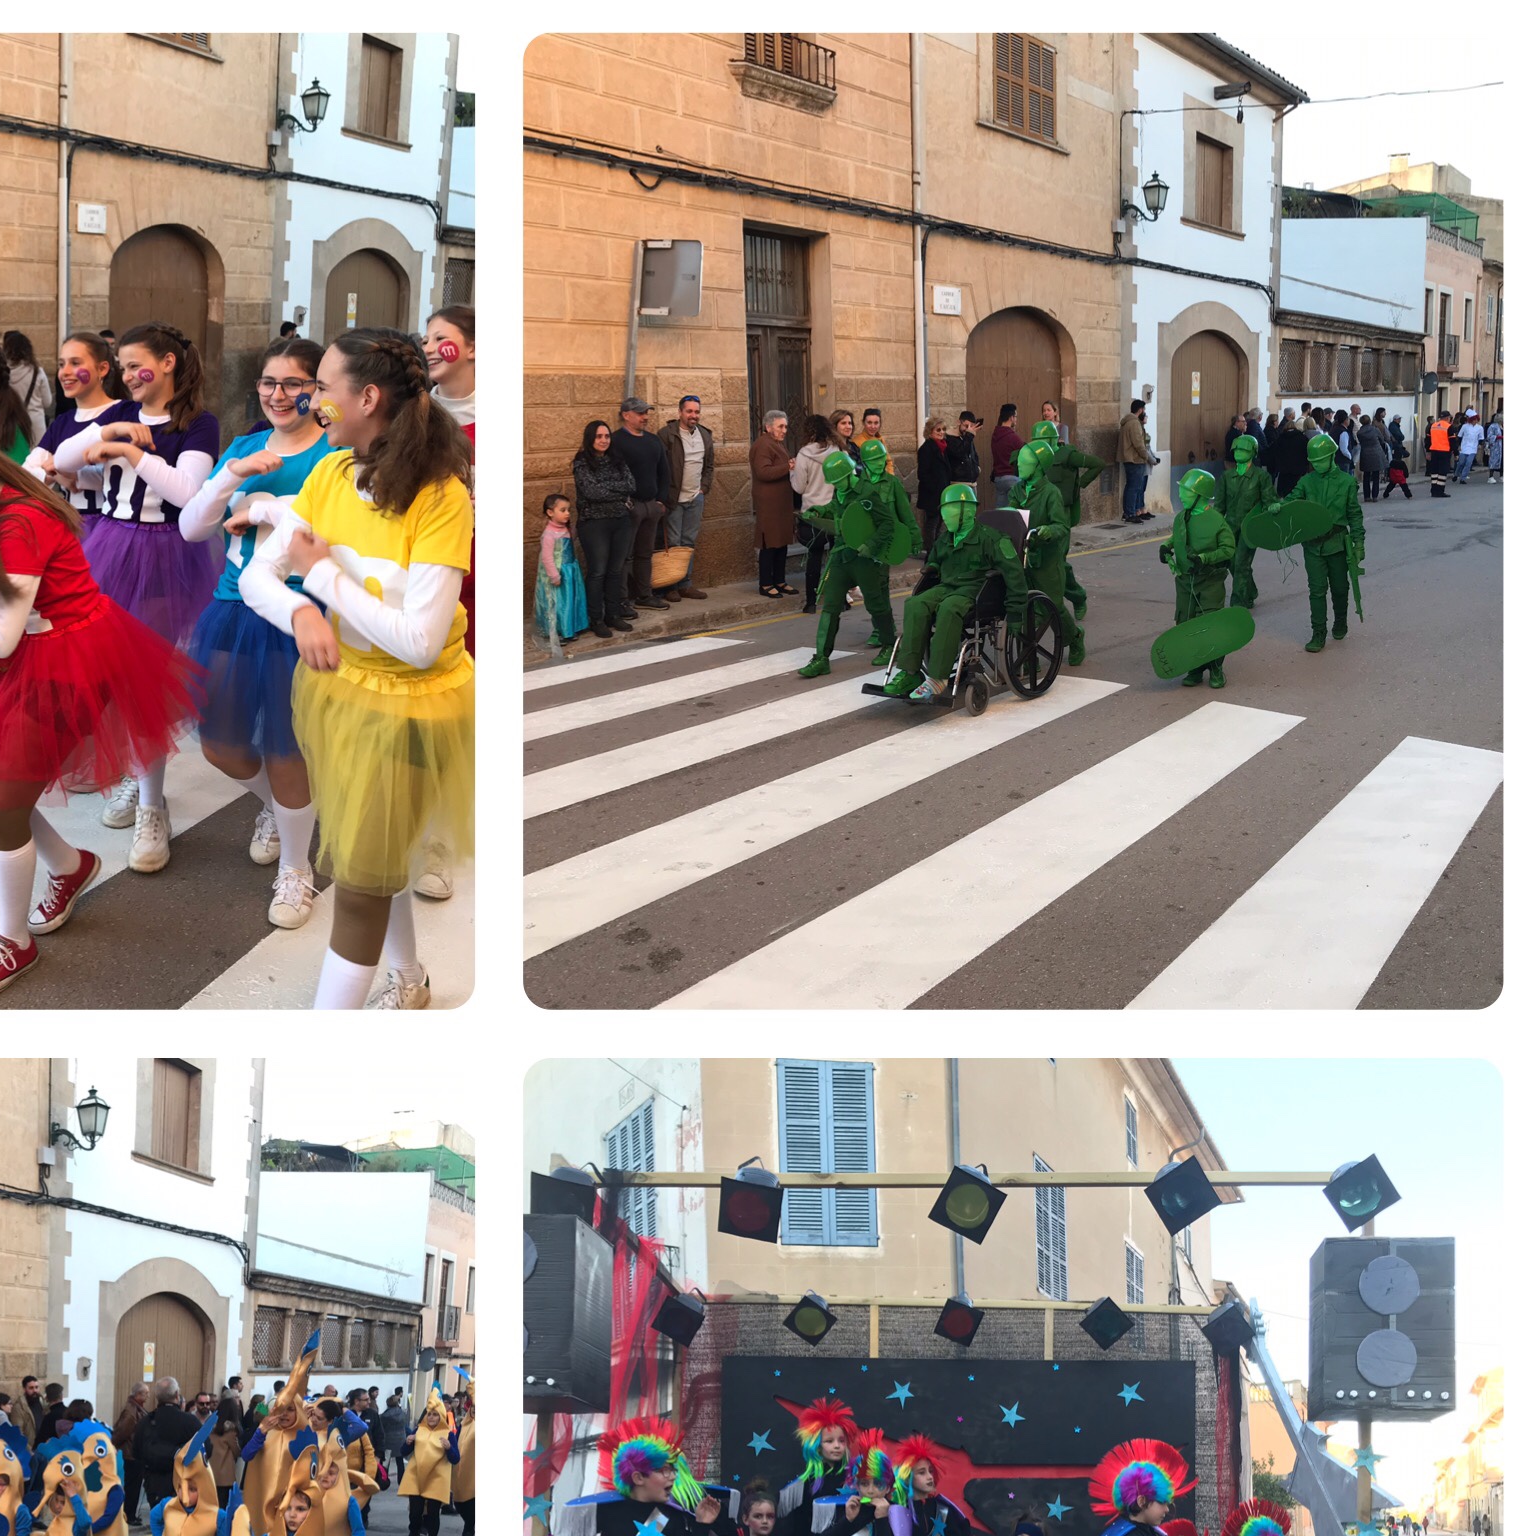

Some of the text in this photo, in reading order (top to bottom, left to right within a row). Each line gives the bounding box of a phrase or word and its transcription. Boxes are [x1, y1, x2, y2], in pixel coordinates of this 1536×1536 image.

[441, 346, 456, 356] m
[298, 398, 310, 410] m
[321, 403, 339, 420] m
